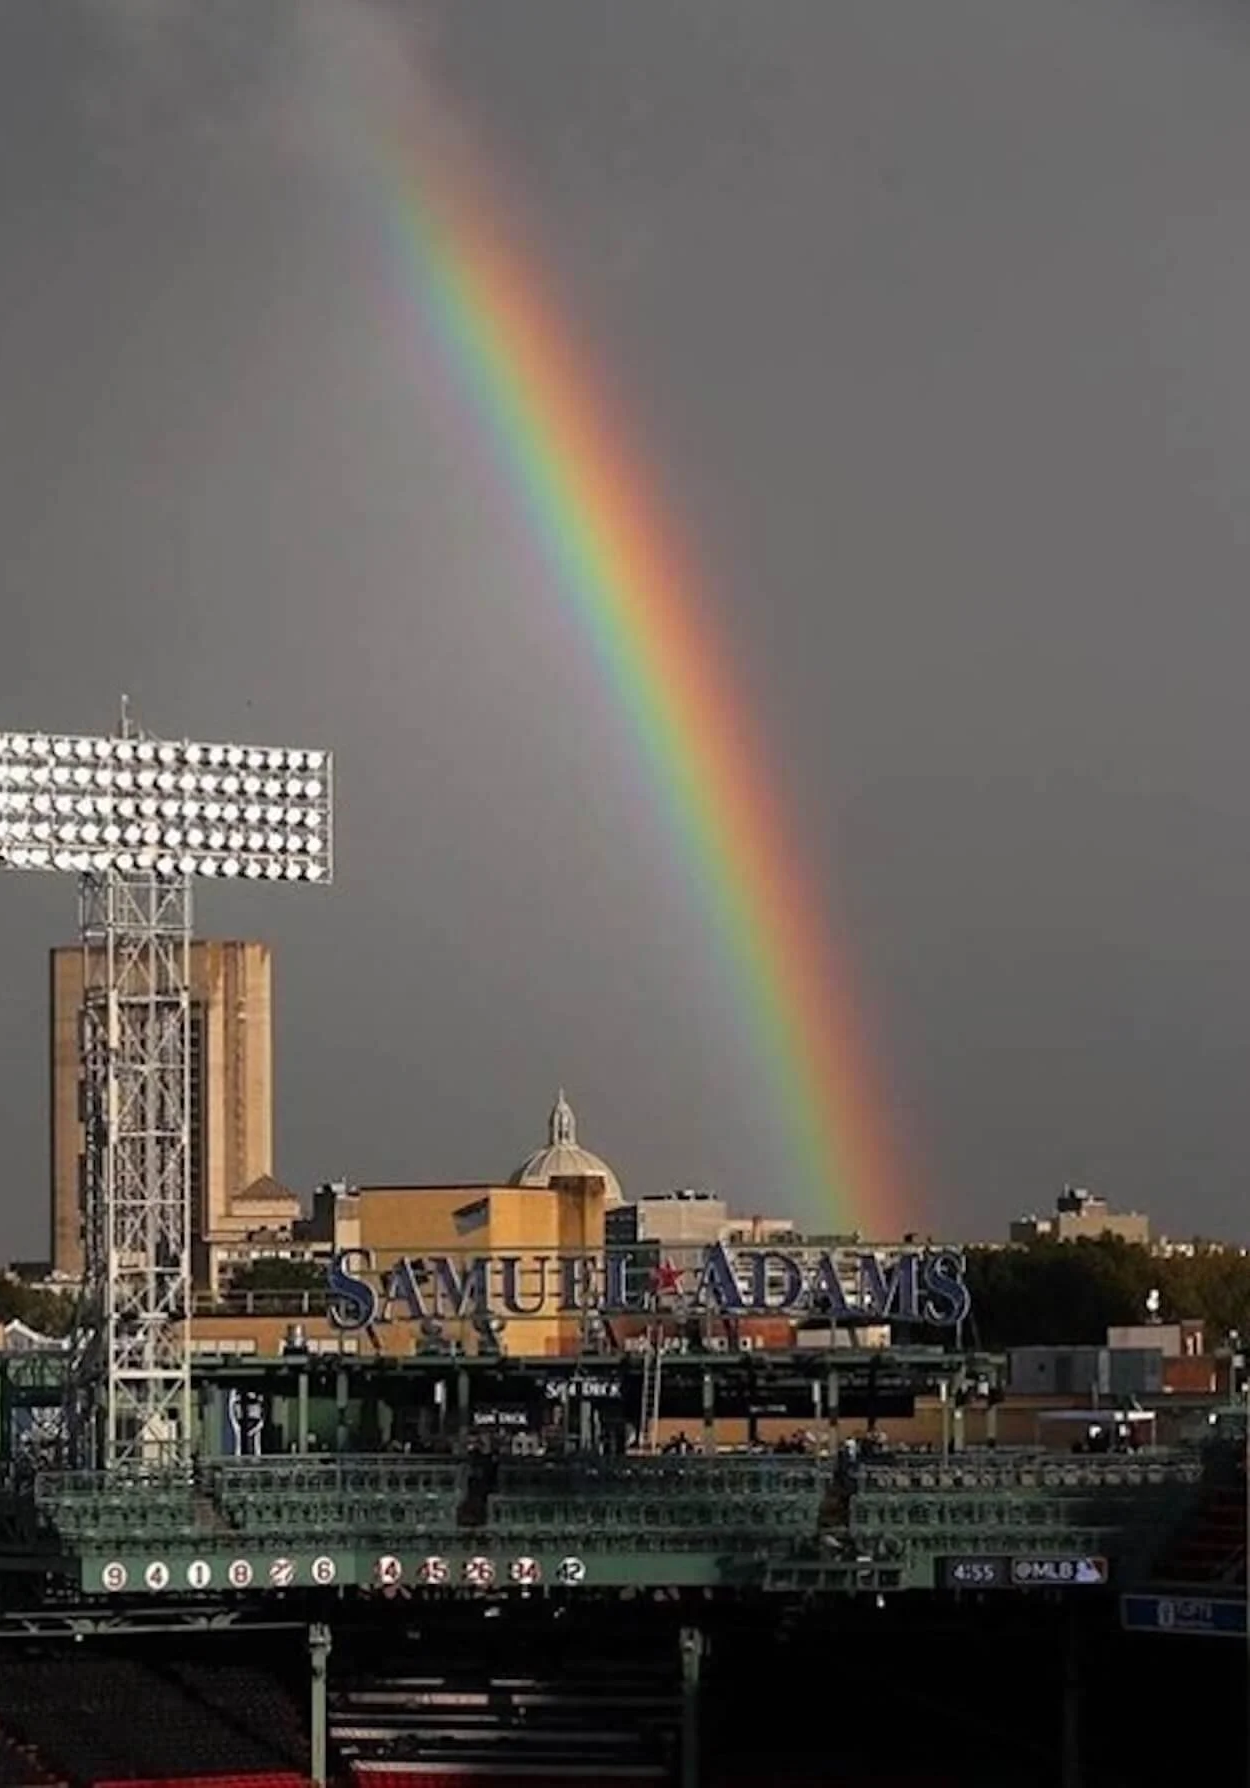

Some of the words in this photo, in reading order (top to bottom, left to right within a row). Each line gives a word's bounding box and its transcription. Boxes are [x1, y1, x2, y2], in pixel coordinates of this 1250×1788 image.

[327, 1246, 659, 1330] SAMUEL
[698, 1240, 971, 1323] ADAMS
[107, 1567, 124, 1587] 9
[233, 1563, 249, 1584] 8
[317, 1560, 332, 1580] 6
[953, 1563, 996, 1581] 4:55
